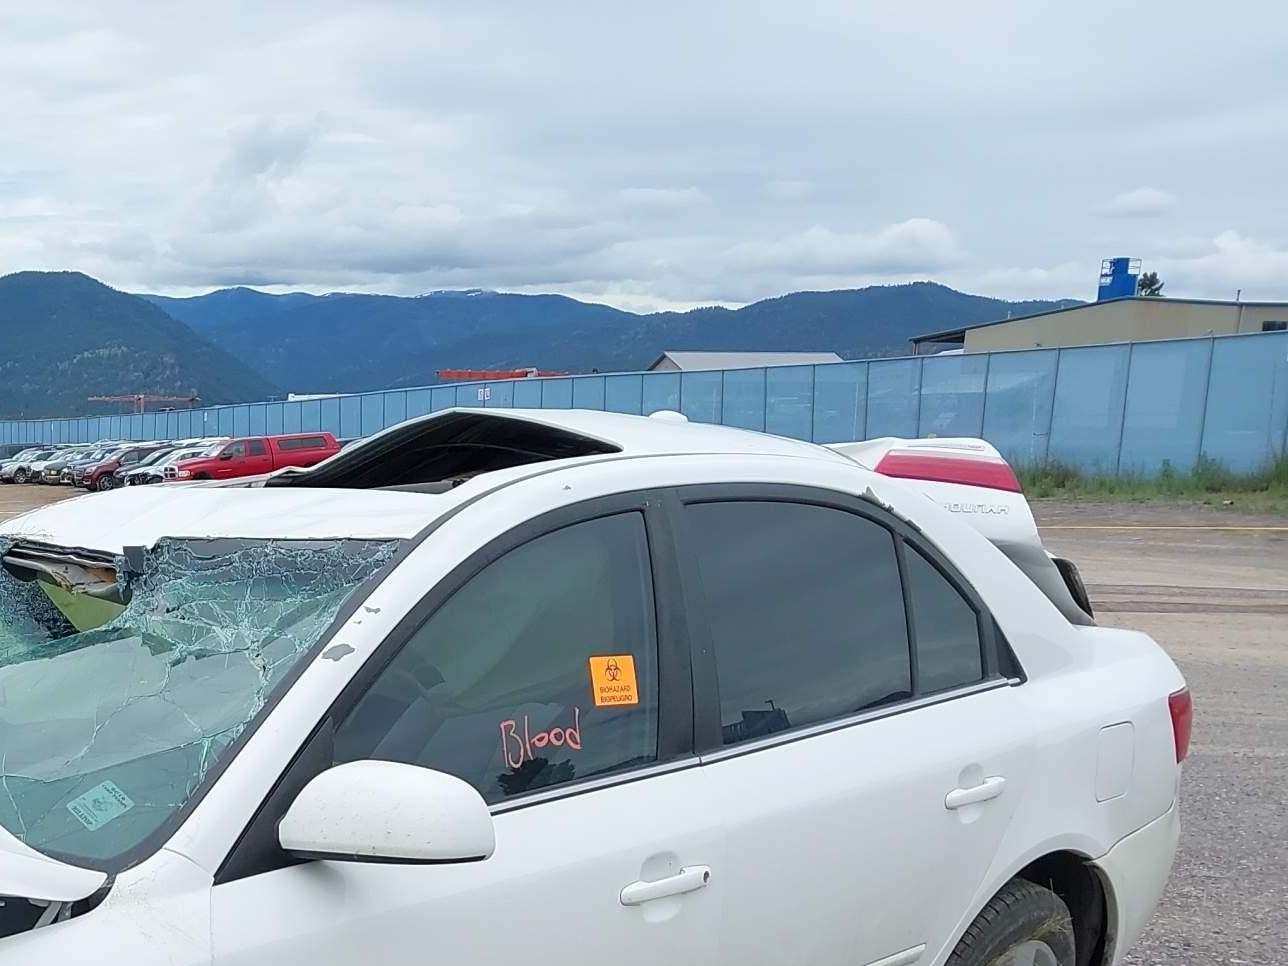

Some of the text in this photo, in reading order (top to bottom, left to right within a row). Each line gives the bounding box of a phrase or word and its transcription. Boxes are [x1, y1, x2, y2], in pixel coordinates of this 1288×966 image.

[599, 685, 631, 693] BIOHAZARD
[600, 694, 633, 703] BIOPELIGRO
[498, 706, 582, 769] Blood
